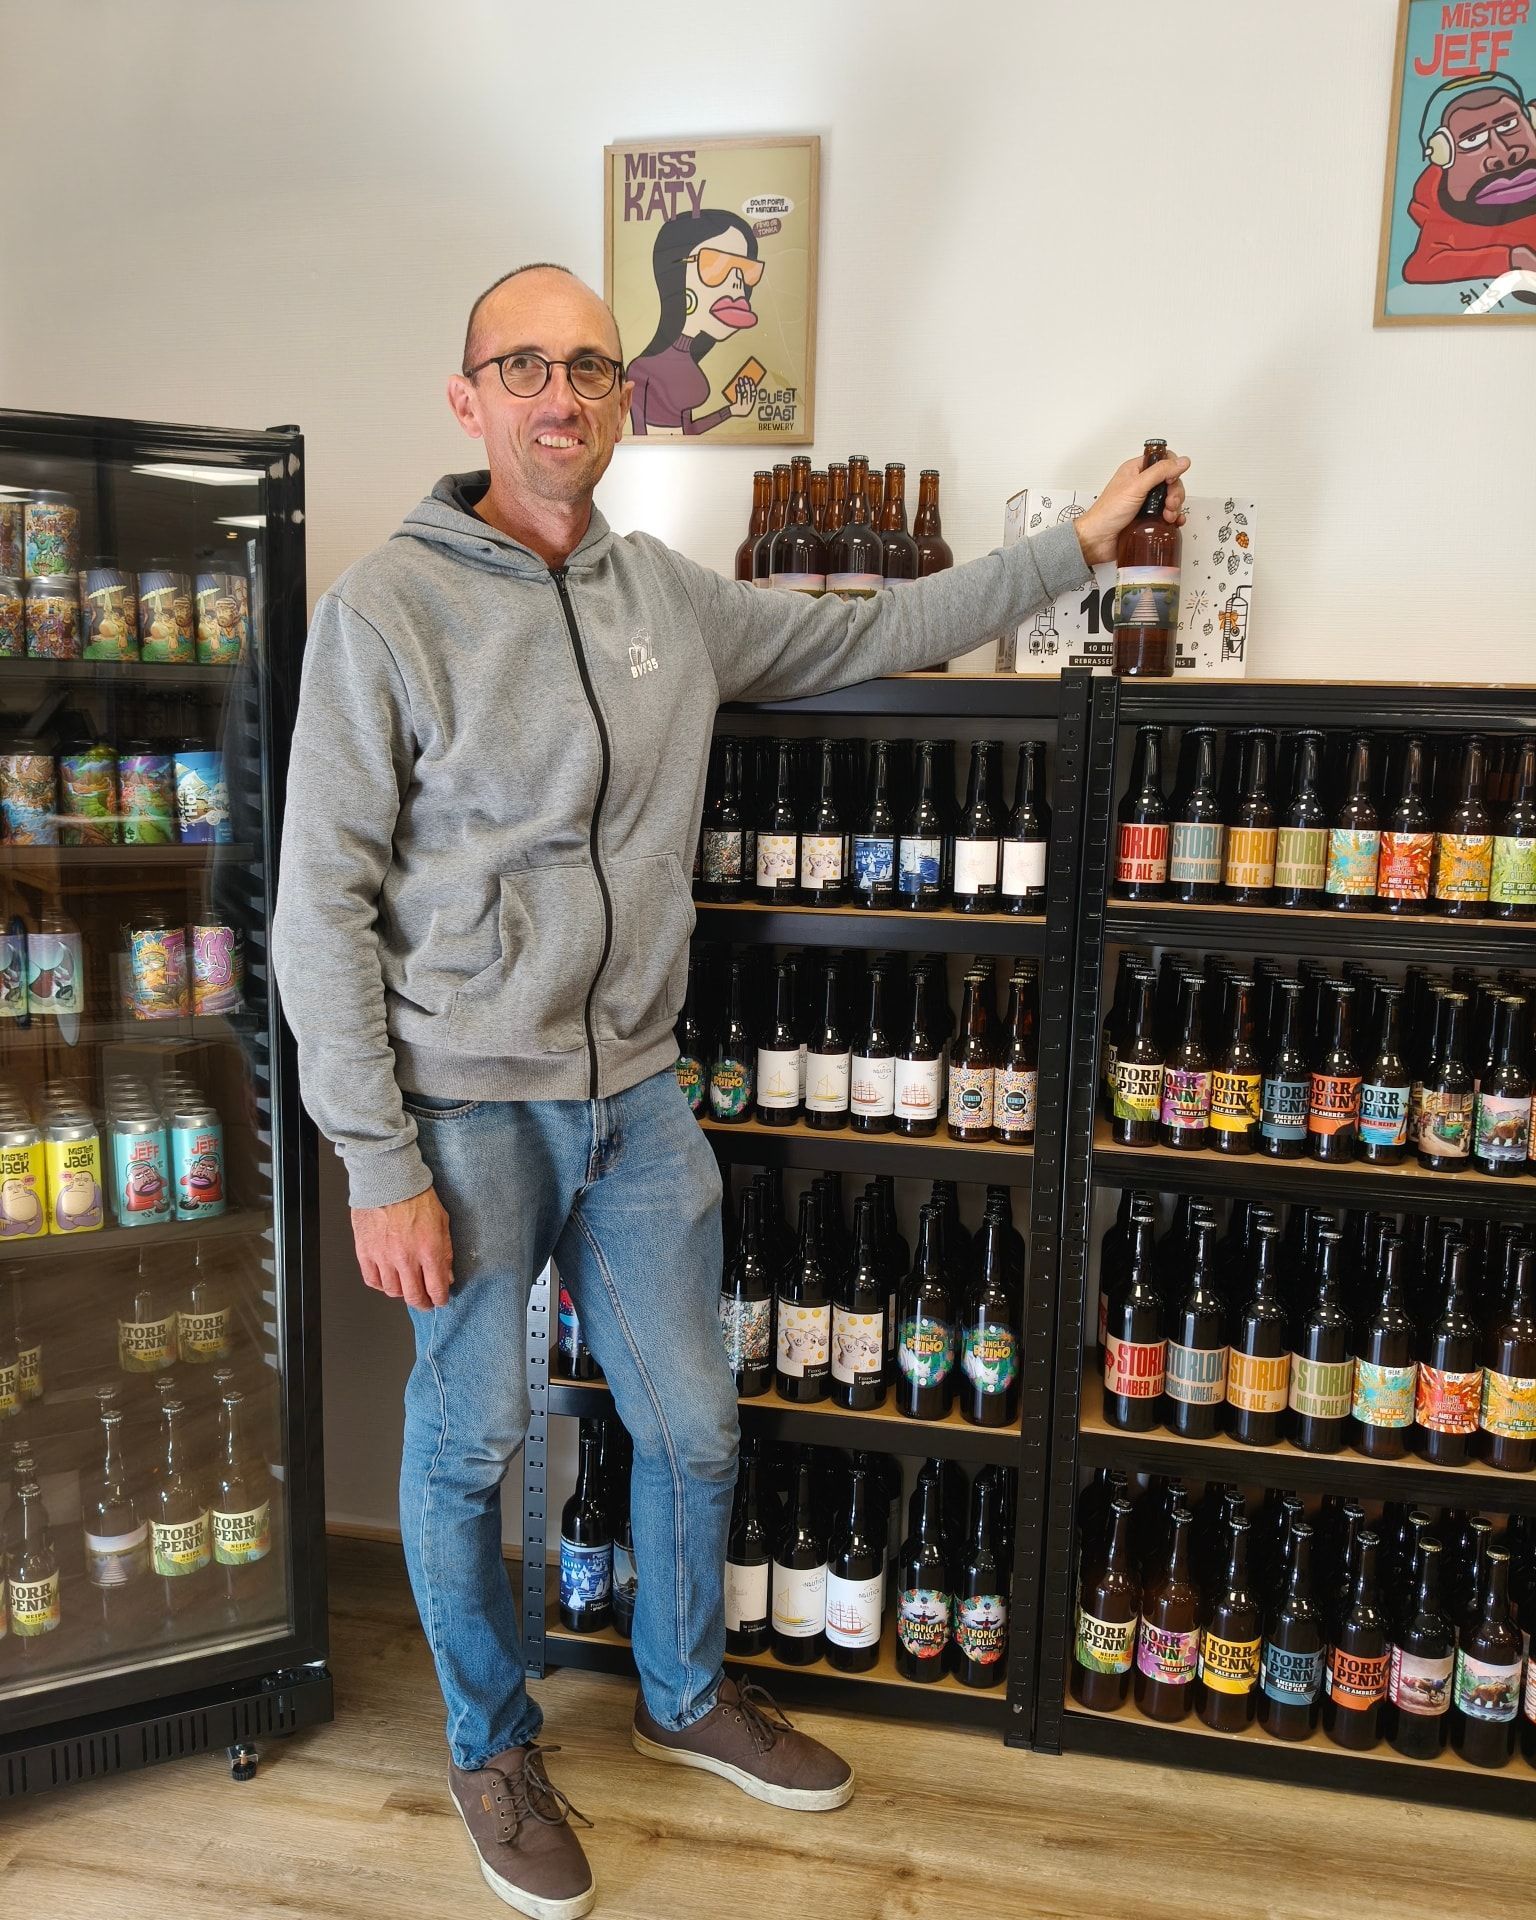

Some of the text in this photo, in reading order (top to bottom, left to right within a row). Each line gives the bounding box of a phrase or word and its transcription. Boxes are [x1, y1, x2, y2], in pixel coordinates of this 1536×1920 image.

[1414, 30, 1513, 77] JEFF
[624, 180, 706, 222] KATY
[758, 388, 797, 404] OUEST
[758, 405, 797, 421] COAST
[758, 422, 794, 431] BREWERY
[1135, 864, 1153, 880] ALE
[1241, 868, 1260, 885] ALE
[1295, 868, 1315, 885] PALE
[714, 1076, 744, 1087] RHINO
[1118, 1067, 1160, 1082] TORR
[1165, 1073, 1197, 1090] ORR
[1118, 1080, 1160, 1096] PENN
[1164, 1087, 1197, 1103] ENN
[1267, 1084, 1311, 1099] TORR
[1266, 1097, 1310, 1113] PENN
[130, 1145, 159, 1160] JEFF
[191, 1138, 218, 1154] JEFF
[184, 1316, 224, 1330] TORR
[126, 1325, 167, 1339] TORR
[185, 1328, 224, 1341] PENN
[912, 1334, 938, 1342] JUNGLE
[126, 1337, 167, 1350] PENN
[906, 1338, 944, 1353] RHINO
[973, 1346, 1011, 1359] RHINO
[1116, 1377, 1150, 1396] AMBER
[1191, 1386, 1213, 1402] WHEAT
[1229, 1386, 1247, 1407] PALE
[1249, 1394, 1267, 1410] ALE
[1296, 1393, 1318, 1415] INDIA
[1320, 1400, 1339, 1416] PALE
[213, 1515, 256, 1529] TORR
[160, 1522, 203, 1541] TORR
[214, 1526, 256, 1542] PENN
[10, 1582, 51, 1599] TORR
[1085, 1617, 1127, 1639] TORR
[1141, 1622, 1181, 1648] TORR
[1083, 1630, 1125, 1651] PENN
[1141, 1637, 1181, 1660] PENN
[1209, 1639, 1252, 1658] TORR
[1208, 1651, 1252, 1671] PENN
[1271, 1649, 1314, 1668] TORR
[1337, 1653, 1382, 1674] TORR
[1160, 1663, 1181, 1672] WHEAT
[1214, 1669, 1230, 1678] PALE
[1270, 1661, 1314, 1682] PENN
[1275, 1679, 1307, 1688] AMERICAN
[1336, 1666, 1382, 1686] PENN
[1277, 1683, 1293, 1692] PALE
[1338, 1684, 1350, 1692] ALE
